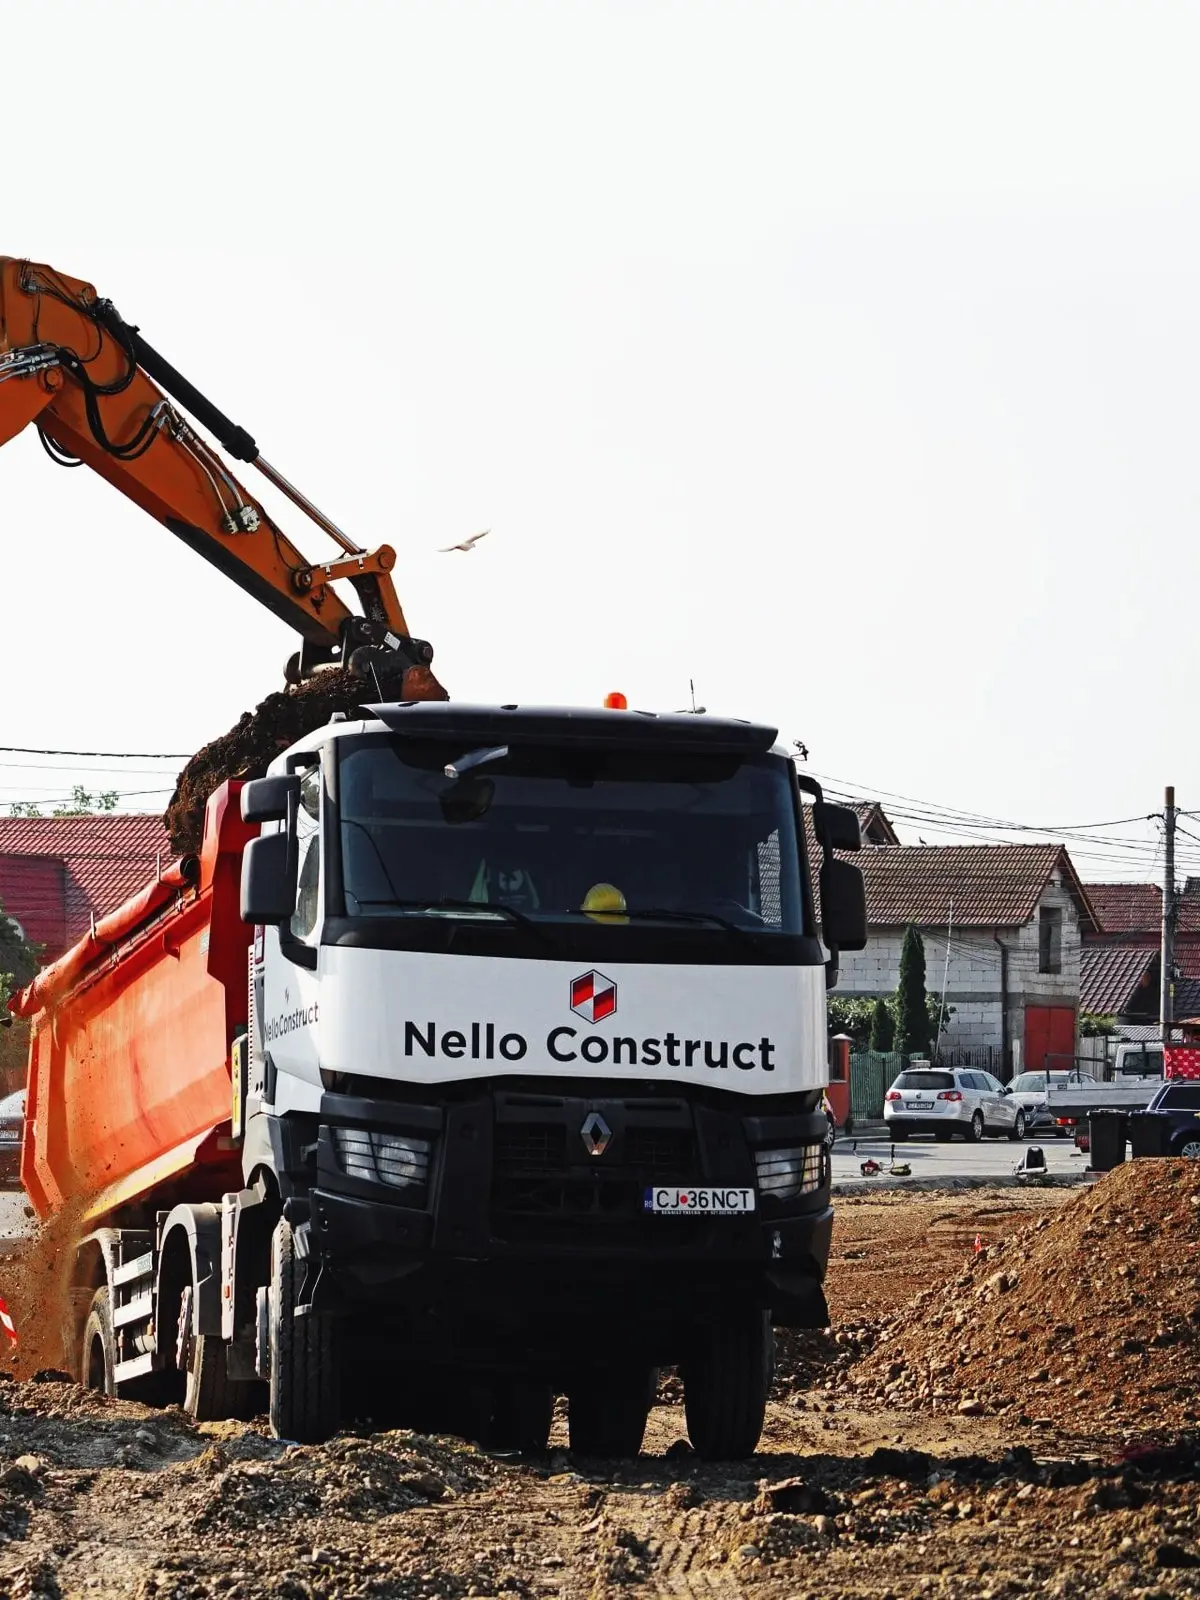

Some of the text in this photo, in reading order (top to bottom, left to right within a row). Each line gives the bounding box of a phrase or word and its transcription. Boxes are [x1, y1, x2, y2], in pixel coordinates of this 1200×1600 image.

[280, 1001, 319, 1036] Construct
[404, 1021, 776, 1071] Nello Construct
